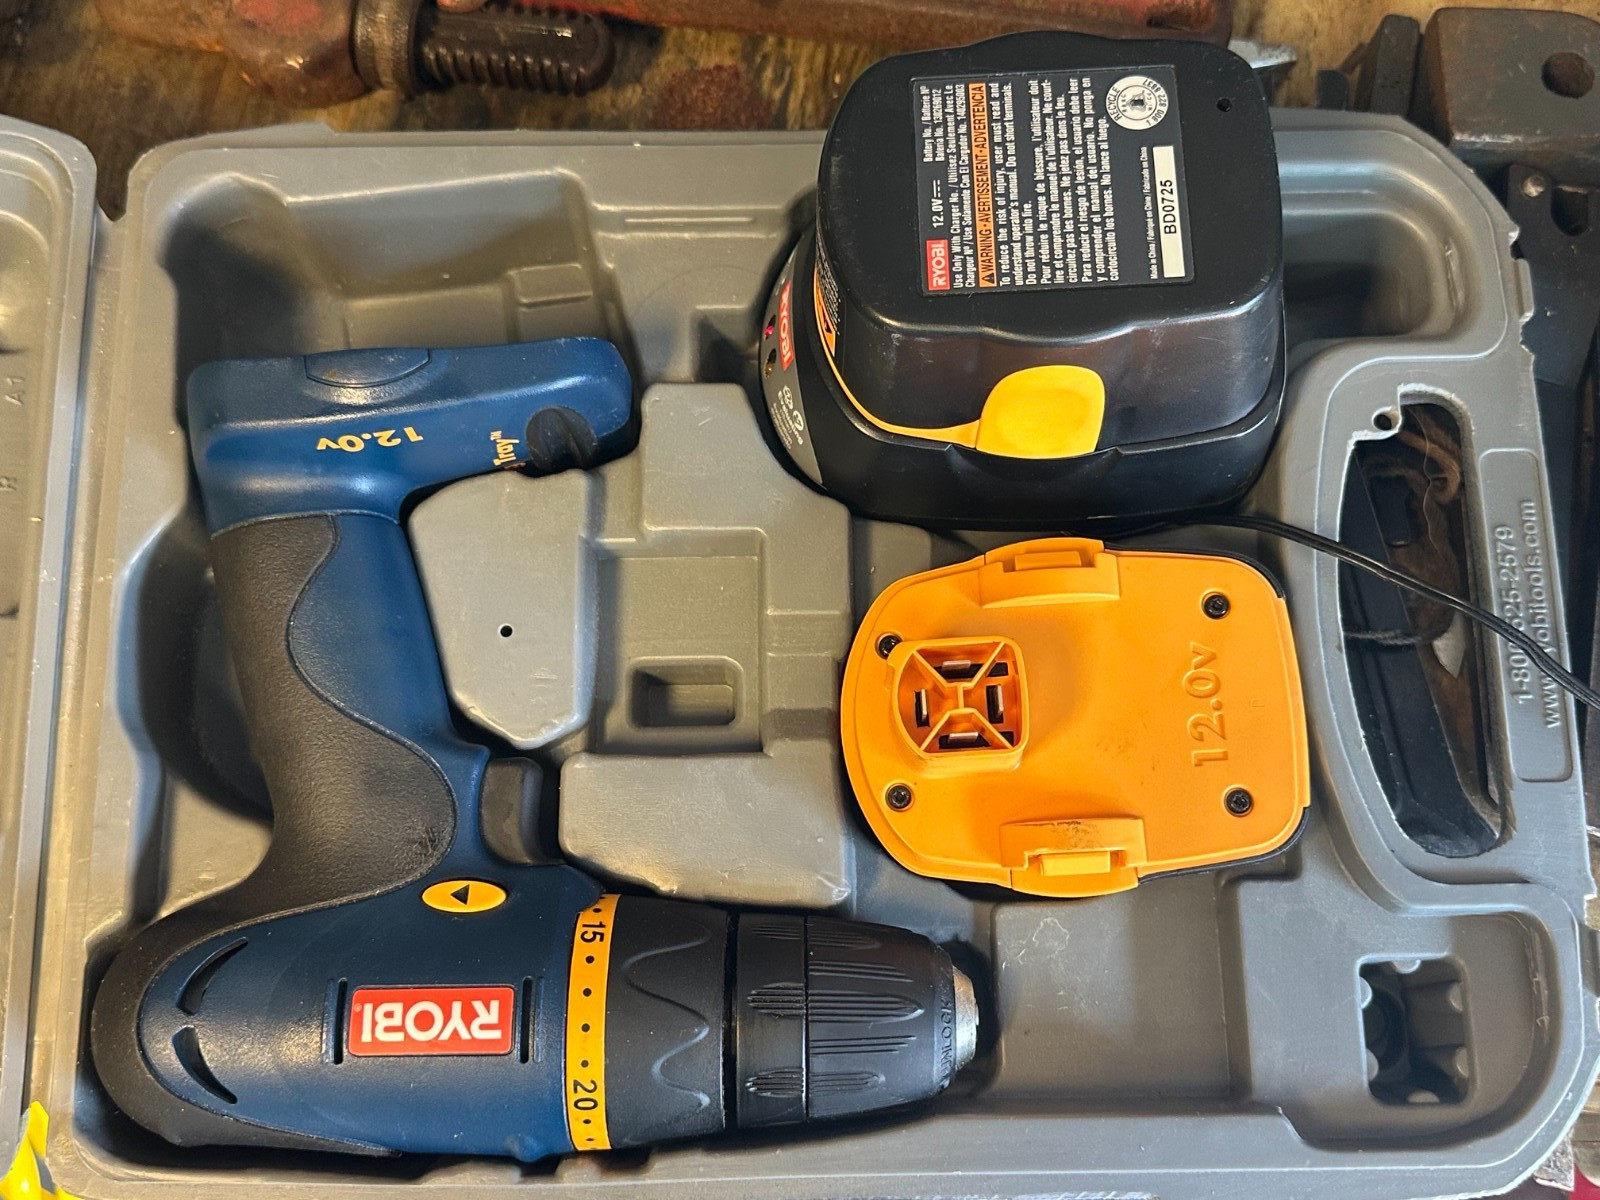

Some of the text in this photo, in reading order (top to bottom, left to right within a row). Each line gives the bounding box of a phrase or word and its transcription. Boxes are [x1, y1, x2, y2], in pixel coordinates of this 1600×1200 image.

[944, 84, 953, 94] Le
[989, 83, 999, 98] and
[1028, 80, 1039, 95] doit
[1067, 78, 1079, 94] leer
[1082, 77, 1091, 87] en
[920, 95, 931, 121] Batterie
[944, 95, 954, 113] Avec
[990, 101, 1001, 119] read
[1042, 103, 1053, 113] Ne
[1069, 95, 1080, 114] debe
[1083, 90, 1095, 114] ponga
[1108, 86, 1122, 121] RECYCLE
[934, 125, 944, 137] No.
[957, 121, 967, 134] No.
[1004, 122, 1015, 141] short
[1056, 120, 1068, 138] dans
[1072, 116, 1083, 145] usuario
[1083, 117, 1094, 128] No
[922, 126, 932, 138] No.
[945, 114, 957, 153] Seulement
[992, 122, 1002, 142] must
[922, 139, 935, 162] Battery
[957, 134, 971, 165] Cargador
[994, 146, 1003, 164] user
[1005, 142, 1016, 154] not
[1059, 140, 1070, 154] pas
[1072, 146, 1083, 154] el
[1098, 142, 1109, 150] al
[947, 154, 958, 183] Utilisez
[959, 166, 969, 174] El
[1005, 156, 1016, 167] Do
[1046, 162, 1057, 171] de
[1058, 155, 1072, 174] jetez
[1099, 151, 1111, 172] lance
[960, 174, 970, 188] Con
[971, 85, 994, 272] WARNING AVERTISSEMENT ADVERTENCIA
[1060, 176, 1071, 187] Ne
[1087, 166, 1098, 179] del
[1100, 174, 1111, 185] No
[949, 190, 959, 203] No.
[1035, 183, 1045, 193] de
[1047, 173, 1059, 202] manuel
[1075, 185, 1086, 195] de
[1088, 181, 1101, 212] manual
[960, 189, 972, 226] Solamente
[995, 197, 1006, 206] of
[1037, 196, 1049, 220] risque
[1049, 203, 1060, 211] le
[1078, 197, 1090, 222] riesgo
[1159, 179, 1177, 234] BD0725
[931, 198, 944, 228] 12.0V
[949, 204, 962, 234] Charger
[996, 209, 1007, 224] risk
[1090, 214, 1101, 223] el
[963, 226, 973, 240] Use
[1022, 219, 1033, 233] into
[1037, 223, 1048, 231] le
[1063, 220, 1074, 232] les
[1078, 223, 1089, 232] el
[1104, 218, 1115, 230] los
[997, 228, 1008, 241] the
[1050, 213, 1065, 259] comprendre
[1066, 233, 1077, 248] pas
[951, 235, 961, 253] With
[1023, 235, 1035, 257] throw
[1038, 234, 1050, 263] réduire
[1078, 233, 1091, 261] reducir
[1091, 225, 1107, 274] comprender
[952, 254, 964, 272] Only
[998, 245, 1010, 273] reduce
[1011, 242, 1024, 285] understand
[1025, 259, 1036, 271] not
[1053, 260, 1064, 268] et
[1105, 231, 1119, 281] cortocircuito
[932, 244, 947, 287] RYOBI
[963, 255, 977, 288] Chargeur
[1040, 265, 1052, 284] Pour
[1065, 249, 1078, 283] circuitez
[1081, 263, 1092, 282] Para
[953, 274, 963, 288] Use
[999, 276, 1011, 286] To
[1026, 274, 1037, 284] Do
[1053, 270, 1065, 283] lire
[317, 426, 424, 452] 12.0v
[1495, 525, 1533, 704] 1-800625-2579
[1520, 500, 1561, 729] wwwyobitools.com
[1182, 640, 1229, 767] 12.0v
[580, 921, 606, 943] 15
[361, 1000, 502, 1042] RYOBI
[573, 1079, 598, 1111] 20
